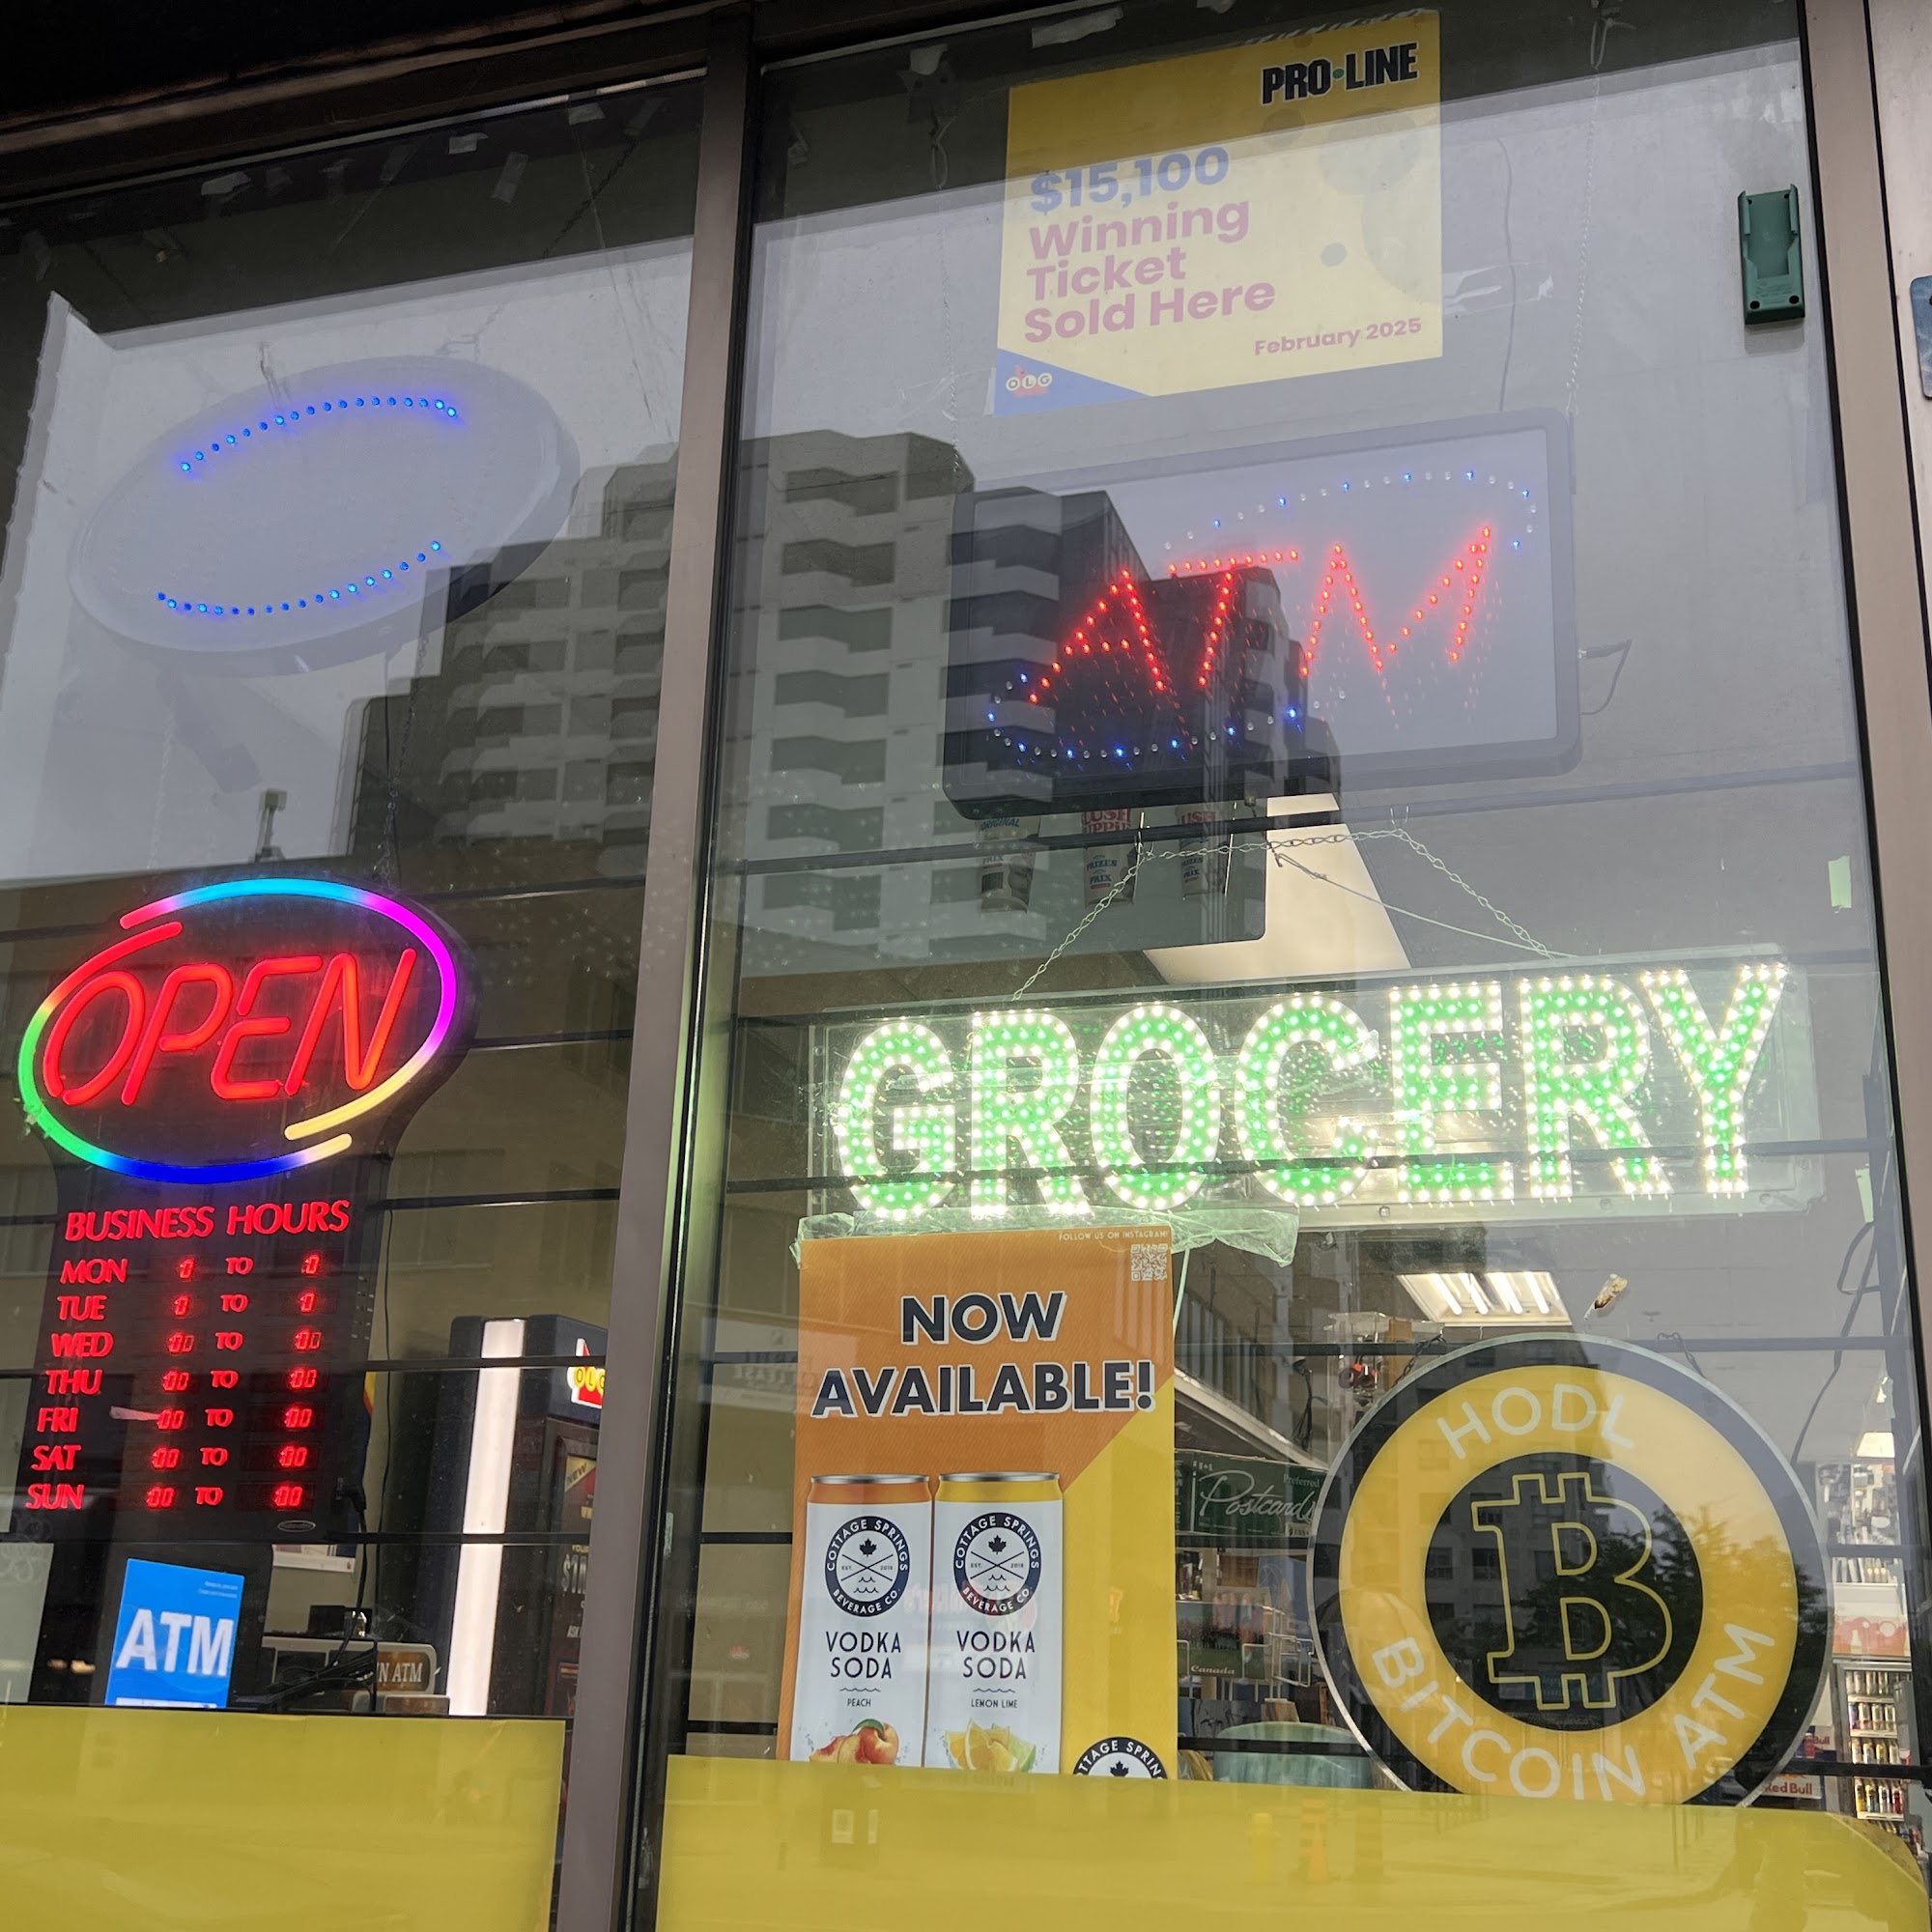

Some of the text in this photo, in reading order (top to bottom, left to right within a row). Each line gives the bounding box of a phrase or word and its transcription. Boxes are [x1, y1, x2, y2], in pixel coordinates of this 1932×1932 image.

[1030, 147, 1230, 215] $15,100
[1029, 201, 1249, 260] Winning
[1026, 247, 1186, 301] Ticket
[1024, 282, 1275, 343] Sold Here
[1255, 318, 1422, 355] February 2025
[1007, 373, 1051, 390] OLG
[1028, 524, 1492, 705] ATM
[43, 948, 417, 1106] OPEN
[835, 963, 1789, 1219] GROCERY
[65, 1200, 351, 1241] BUSINESS HOURS
[1059, 1233, 1092, 1241] FOLLOW
[1107, 1231, 1120, 1239] ON
[60, 1258, 128, 1285] MON
[225, 1257, 254, 1275] TO
[57, 1294, 108, 1321] TUE
[220, 1294, 248, 1313] TO
[901, 1291, 1066, 1345] NOW
[51, 1332, 114, 1358] WED
[214, 1331, 243, 1350] TO
[45, 1369, 102, 1395] THU
[210, 1370, 239, 1388] TO
[810, 1360, 1156, 1418] AVAILABLE!
[37, 1406, 79, 1433] FRI
[205, 1408, 234, 1428] TO
[1435, 1382, 1636, 1461] HODL
[31, 1444, 82, 1471] SAT
[200, 1447, 229, 1466] TO
[25, 1483, 85, 1510] SUN
[195, 1487, 223, 1506] TO
[827, 1519, 908, 1572] COTTAGE SPRINGS
[955, 1515, 1039, 1569] COTTAGE SPRINGS
[833, 1588, 882, 1614] BEVERAGE
[963, 1587, 1013, 1612] BEVERAGE
[116, 1607, 234, 1678] ATM
[826, 1631, 901, 1653] VODKA
[956, 1630, 1036, 1653] VODKA
[392, 1662, 423, 1683] ATM
[830, 1656, 893, 1679] SODA
[962, 1656, 1027, 1680] SODA
[1190, 1663, 1236, 1676] Canada
[847, 1698, 871, 1708] PEACH
[971, 1698, 1018, 1709] LEMON LIME
[1373, 1621, 1776, 1803] BITCOIN ATM
[1125, 1741, 1163, 1779] SPRIN
